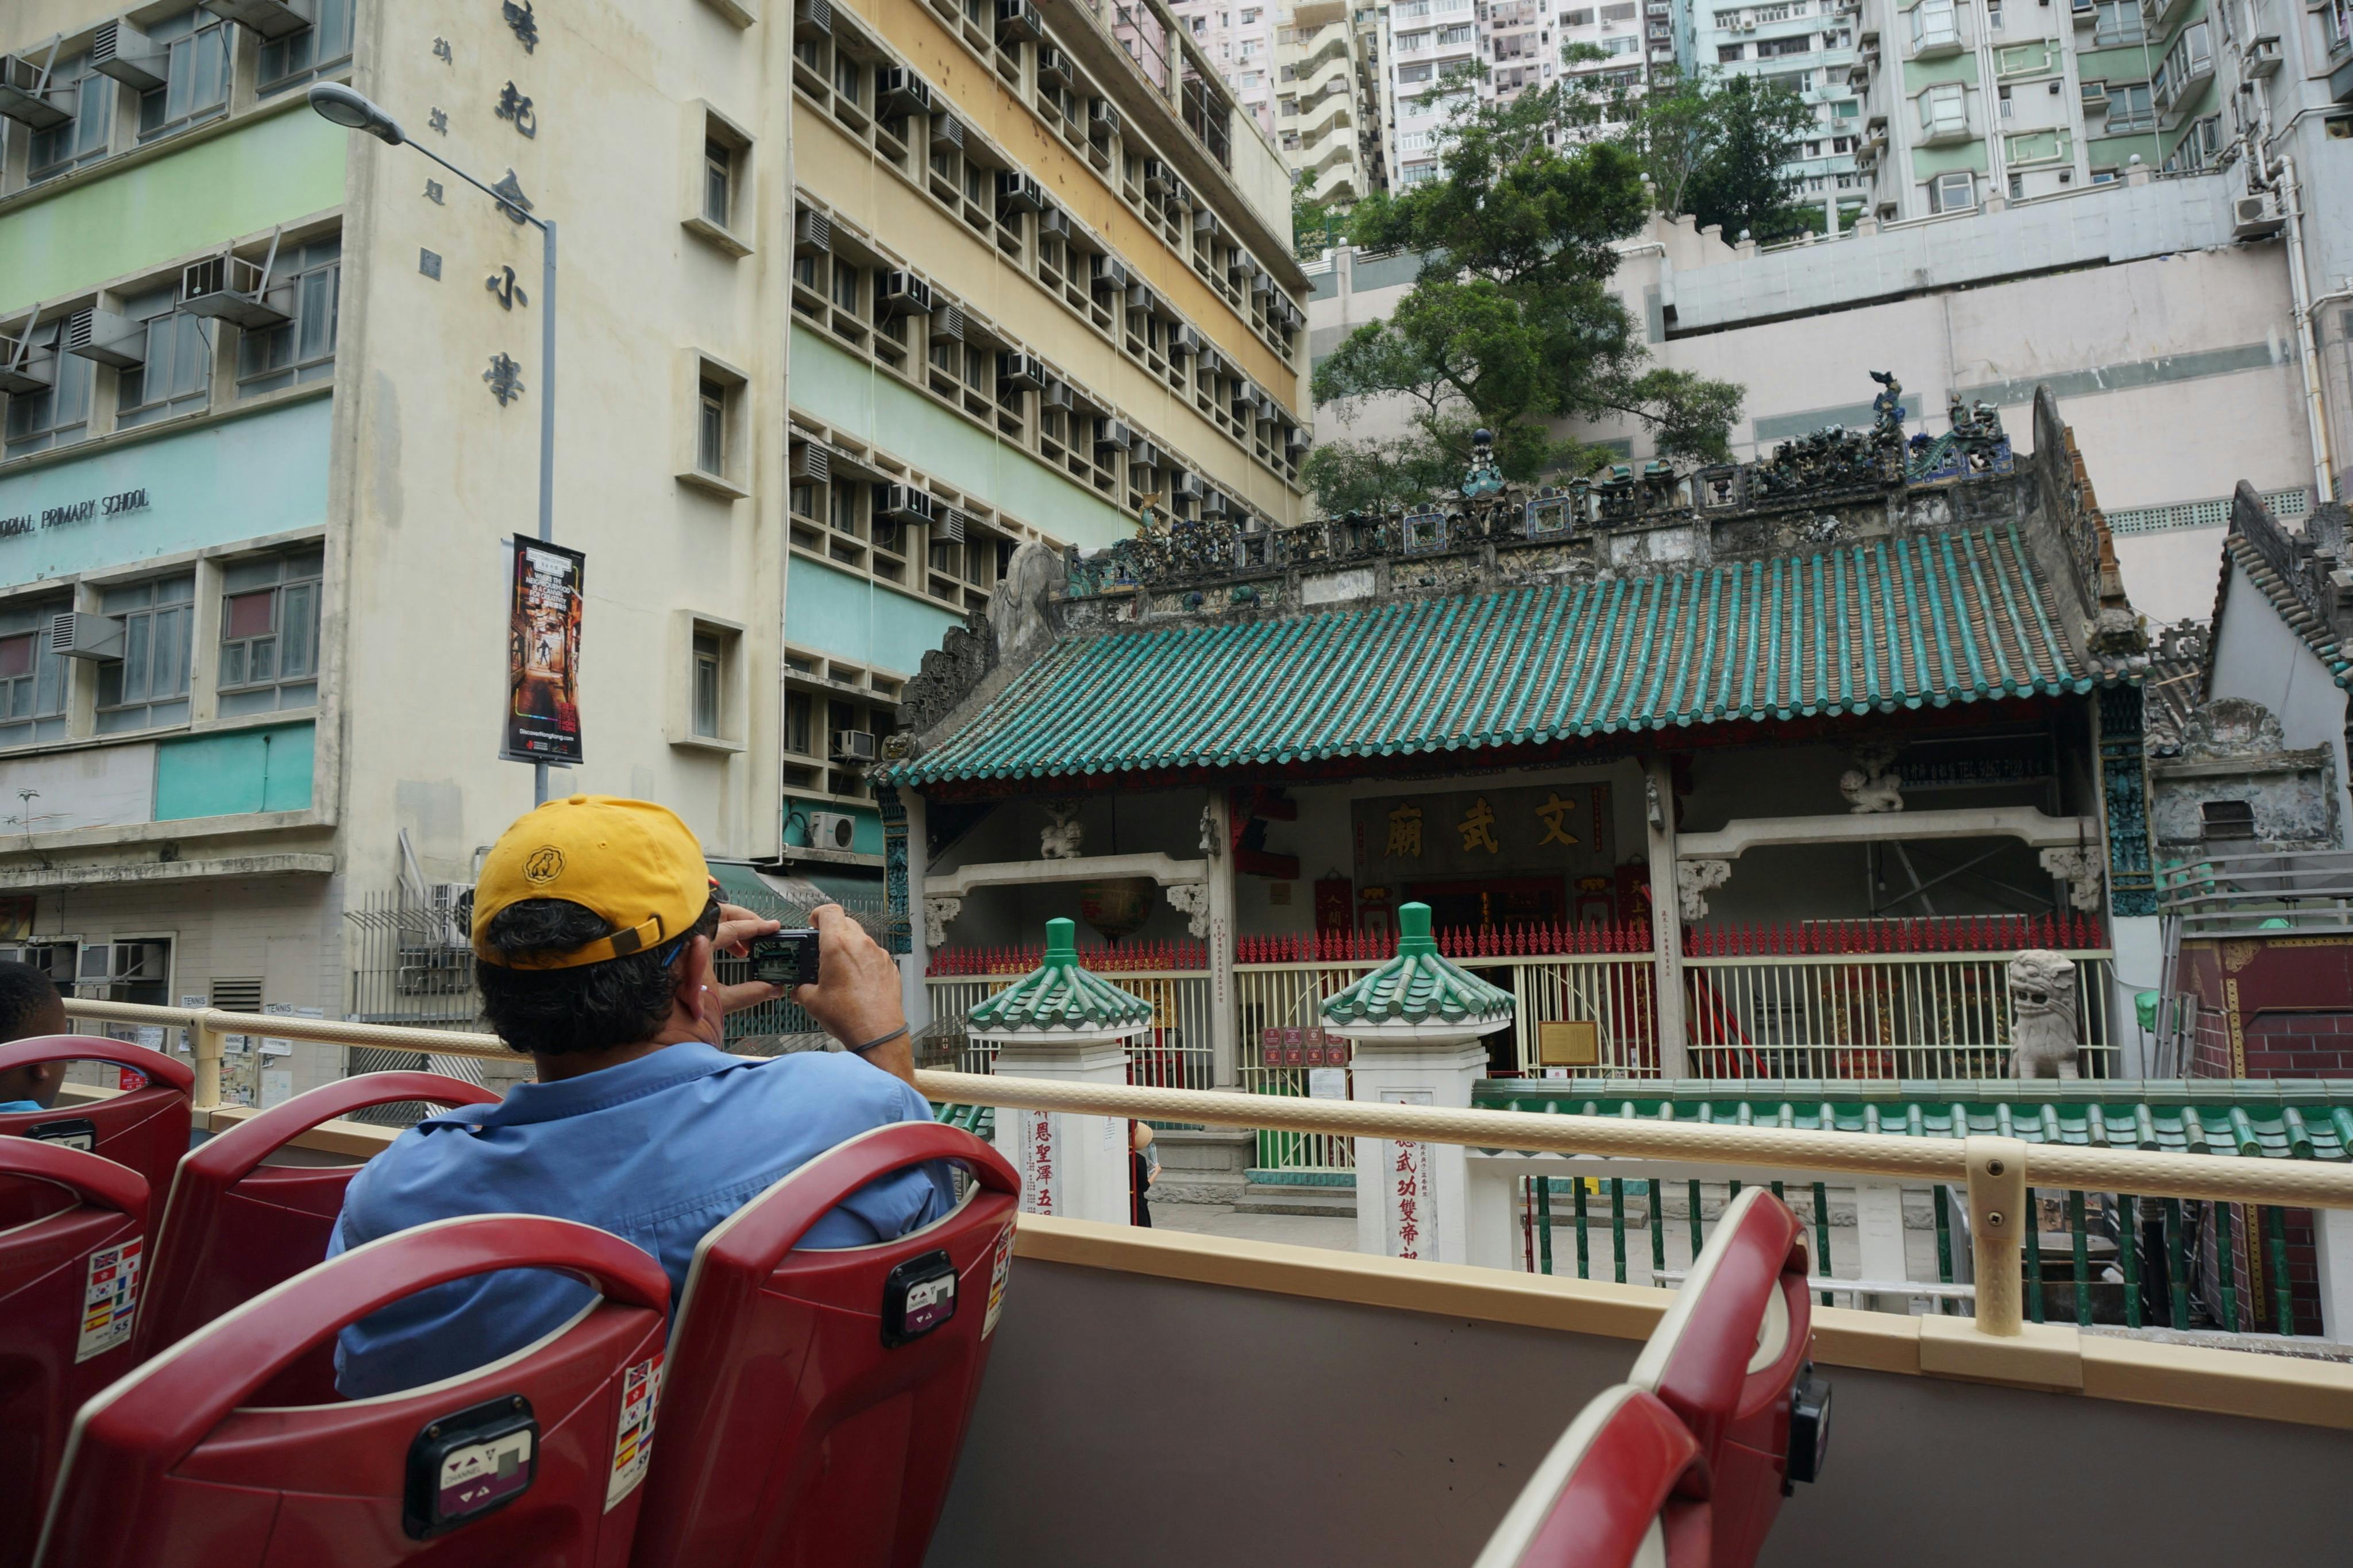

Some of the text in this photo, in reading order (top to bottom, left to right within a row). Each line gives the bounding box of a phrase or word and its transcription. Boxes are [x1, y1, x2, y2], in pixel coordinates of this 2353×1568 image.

[0, 488, 149, 538] ORIAL PRIMARY SCHOOL
[526, 576, 570, 594] NEIGHBOURHOOD
[541, 593, 566, 604] CREATIVITY
[183, 997, 206, 1005] TENNIS
[267, 1003, 291, 1013] TENNIS
[909, 1298, 928, 1310] CHANNEL
[113, 1319, 129, 1335] 55
[445, 1466, 481, 1486] CHANNEL
